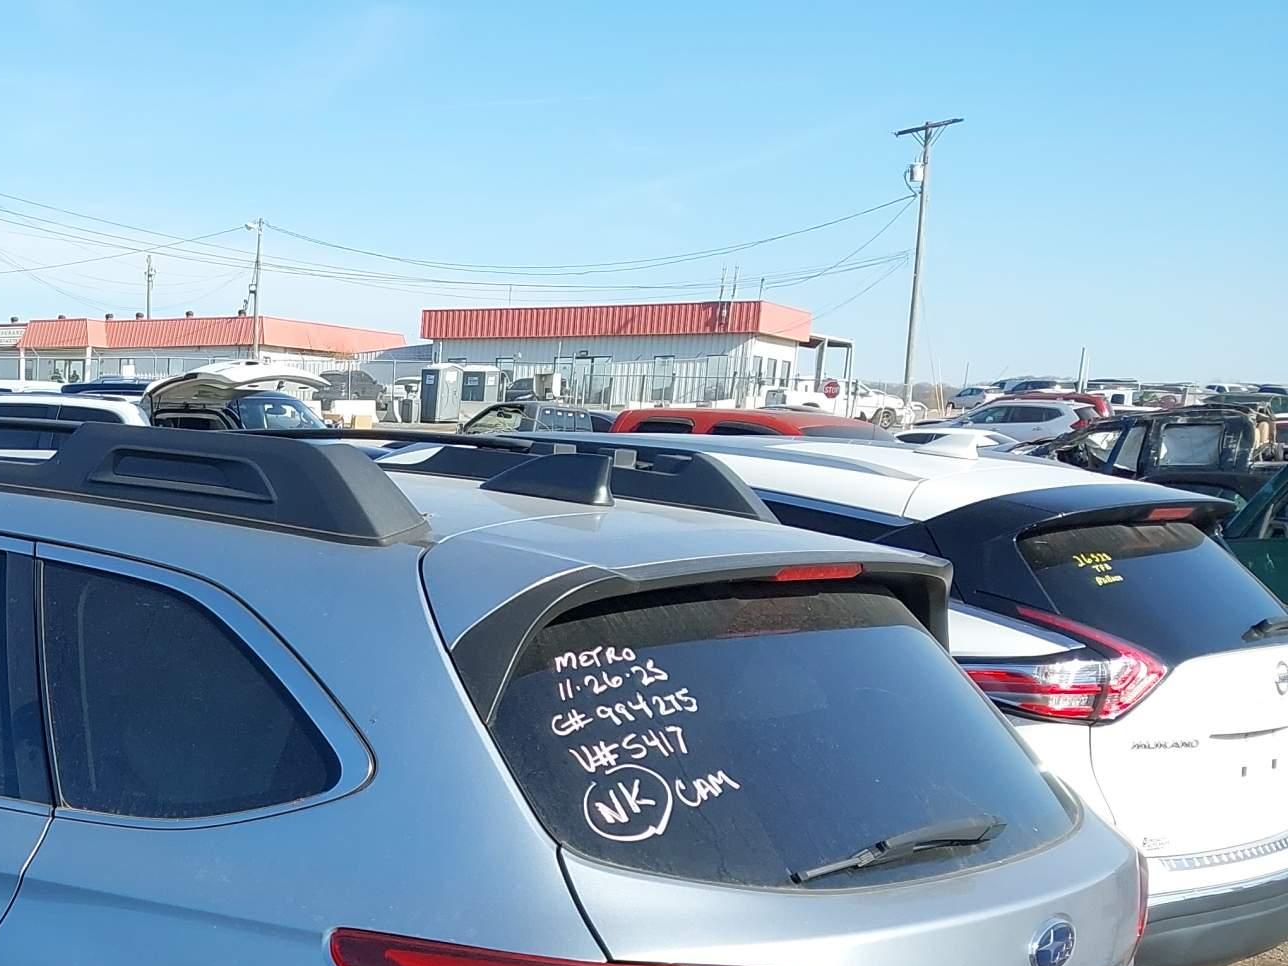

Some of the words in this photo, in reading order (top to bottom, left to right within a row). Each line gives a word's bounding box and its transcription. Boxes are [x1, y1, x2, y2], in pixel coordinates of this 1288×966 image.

[555, 646, 636, 673] METRO
[595, 779, 656, 824] NK
[675, 770, 740, 807] CAM
